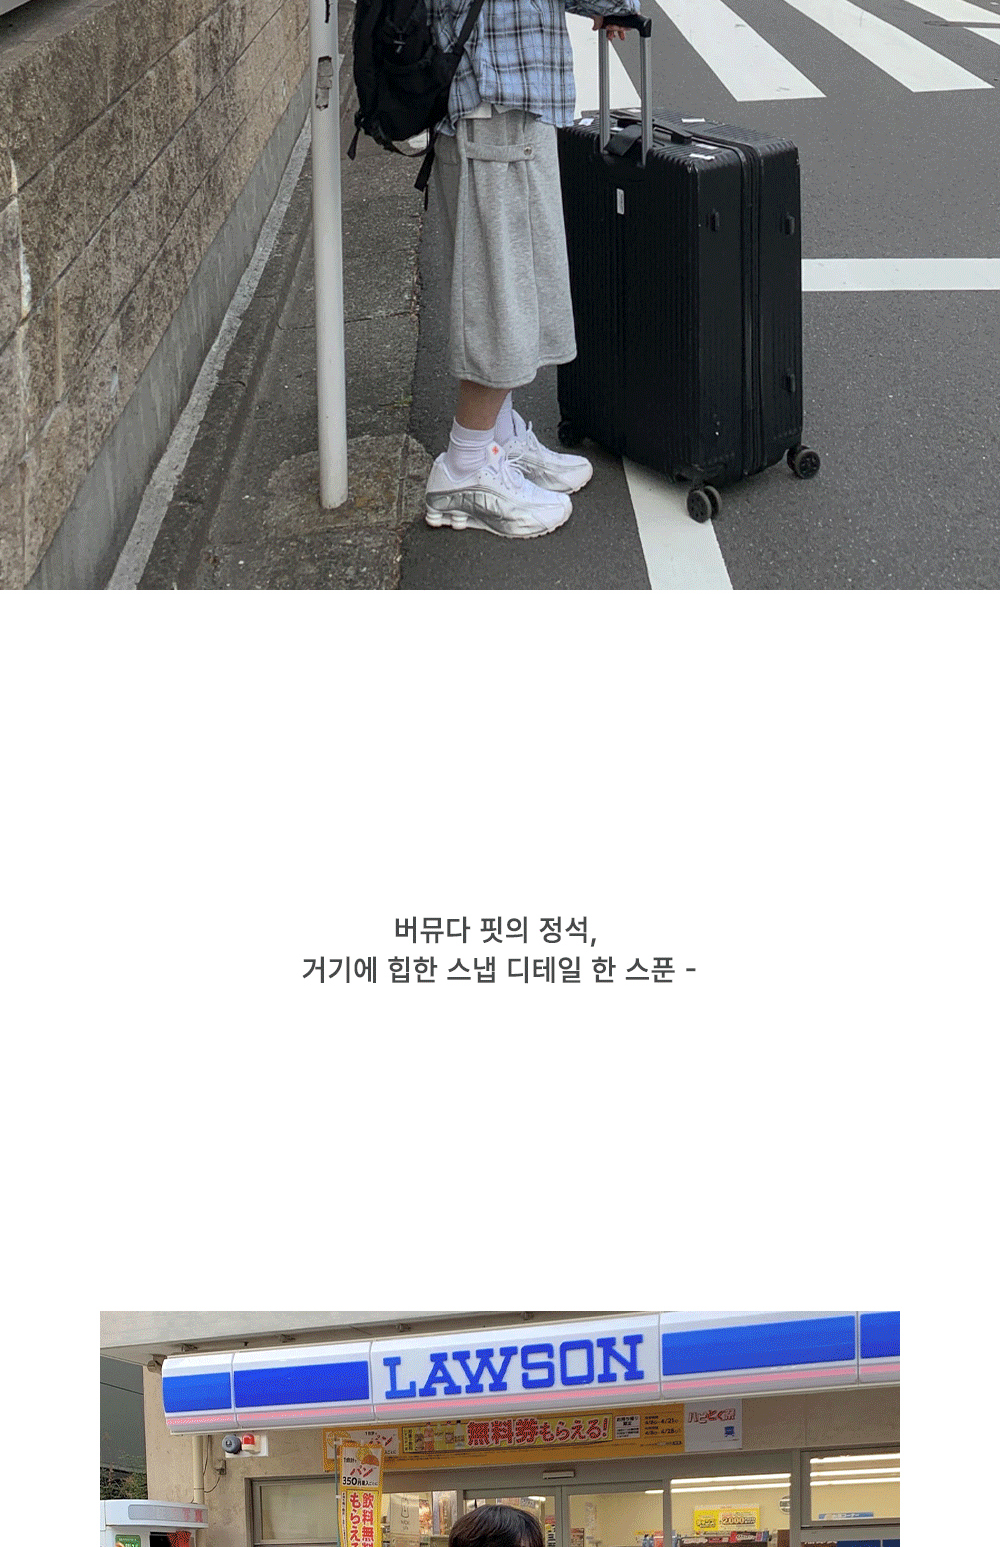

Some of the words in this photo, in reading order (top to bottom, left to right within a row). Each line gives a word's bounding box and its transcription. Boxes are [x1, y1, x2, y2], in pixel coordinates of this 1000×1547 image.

[383, 1334, 645, 1399] LAWSON
[467, 1417, 609, 1446] 無料券もらえる!
[349, 1465, 374, 1478] パン
